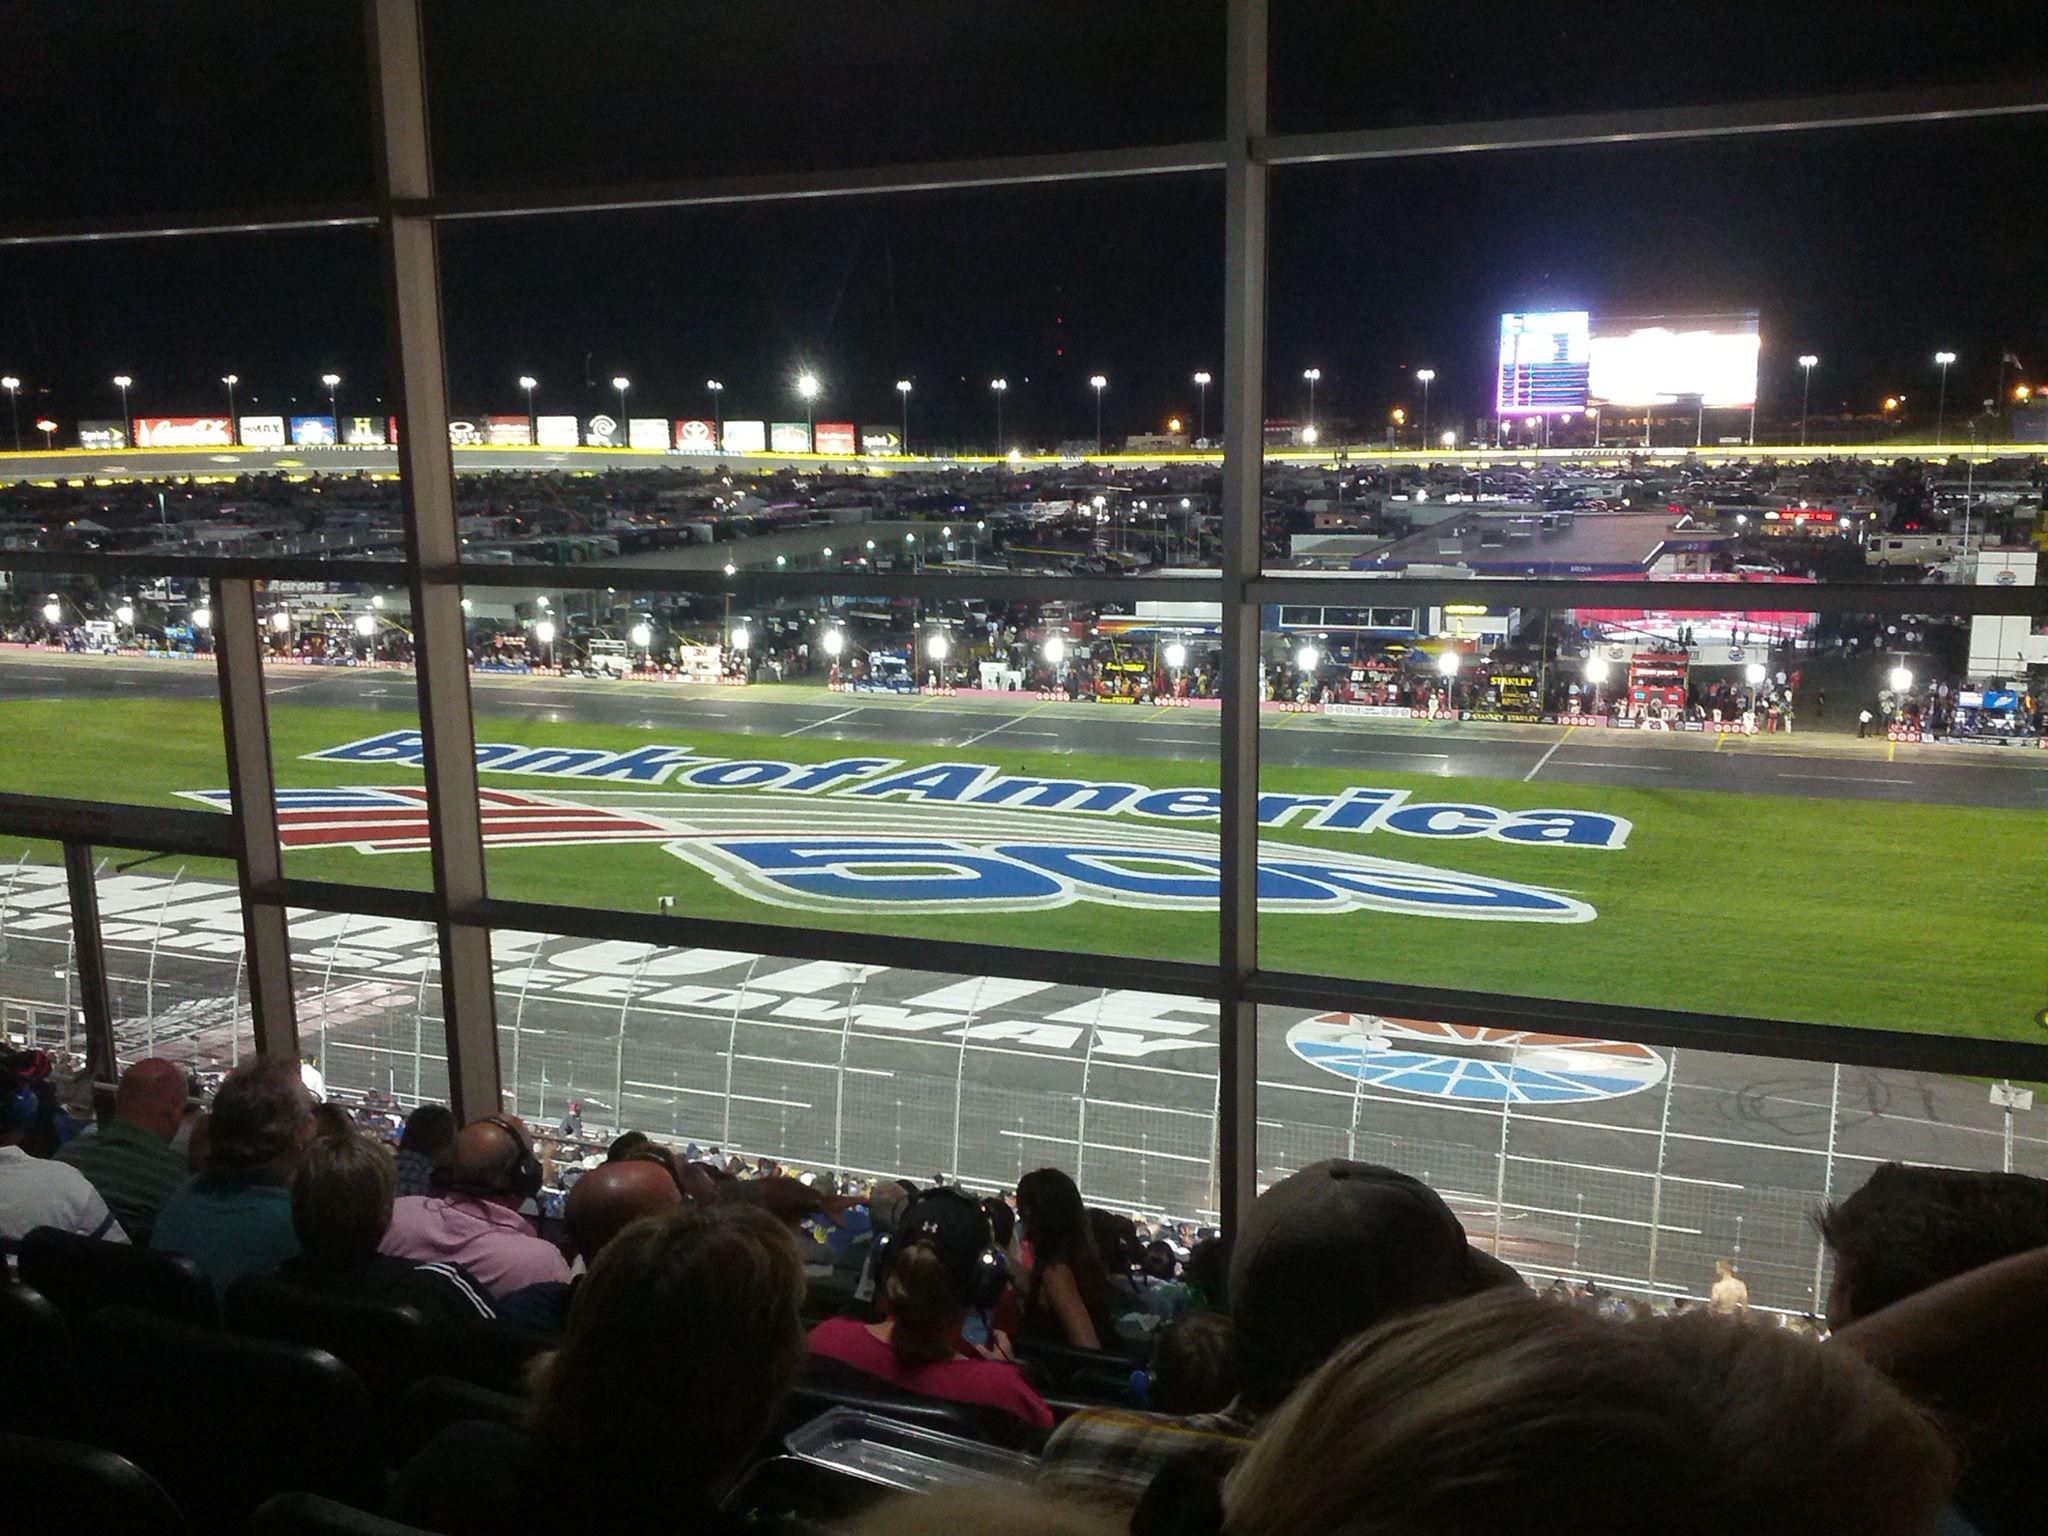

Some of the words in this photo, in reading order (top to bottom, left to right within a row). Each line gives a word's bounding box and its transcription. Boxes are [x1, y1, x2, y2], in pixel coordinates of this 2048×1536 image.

[268, 580, 326, 592] Aaron's
[1490, 677, 1534, 686] STANLEY
[1472, 713, 1504, 721] STANLEY
[1507, 714, 1539, 722] STANLEY
[297, 728, 733, 786] Bank
[676, 757, 906, 795] of
[825, 762, 1633, 850] America
[662, 836, 1598, 923] 500
